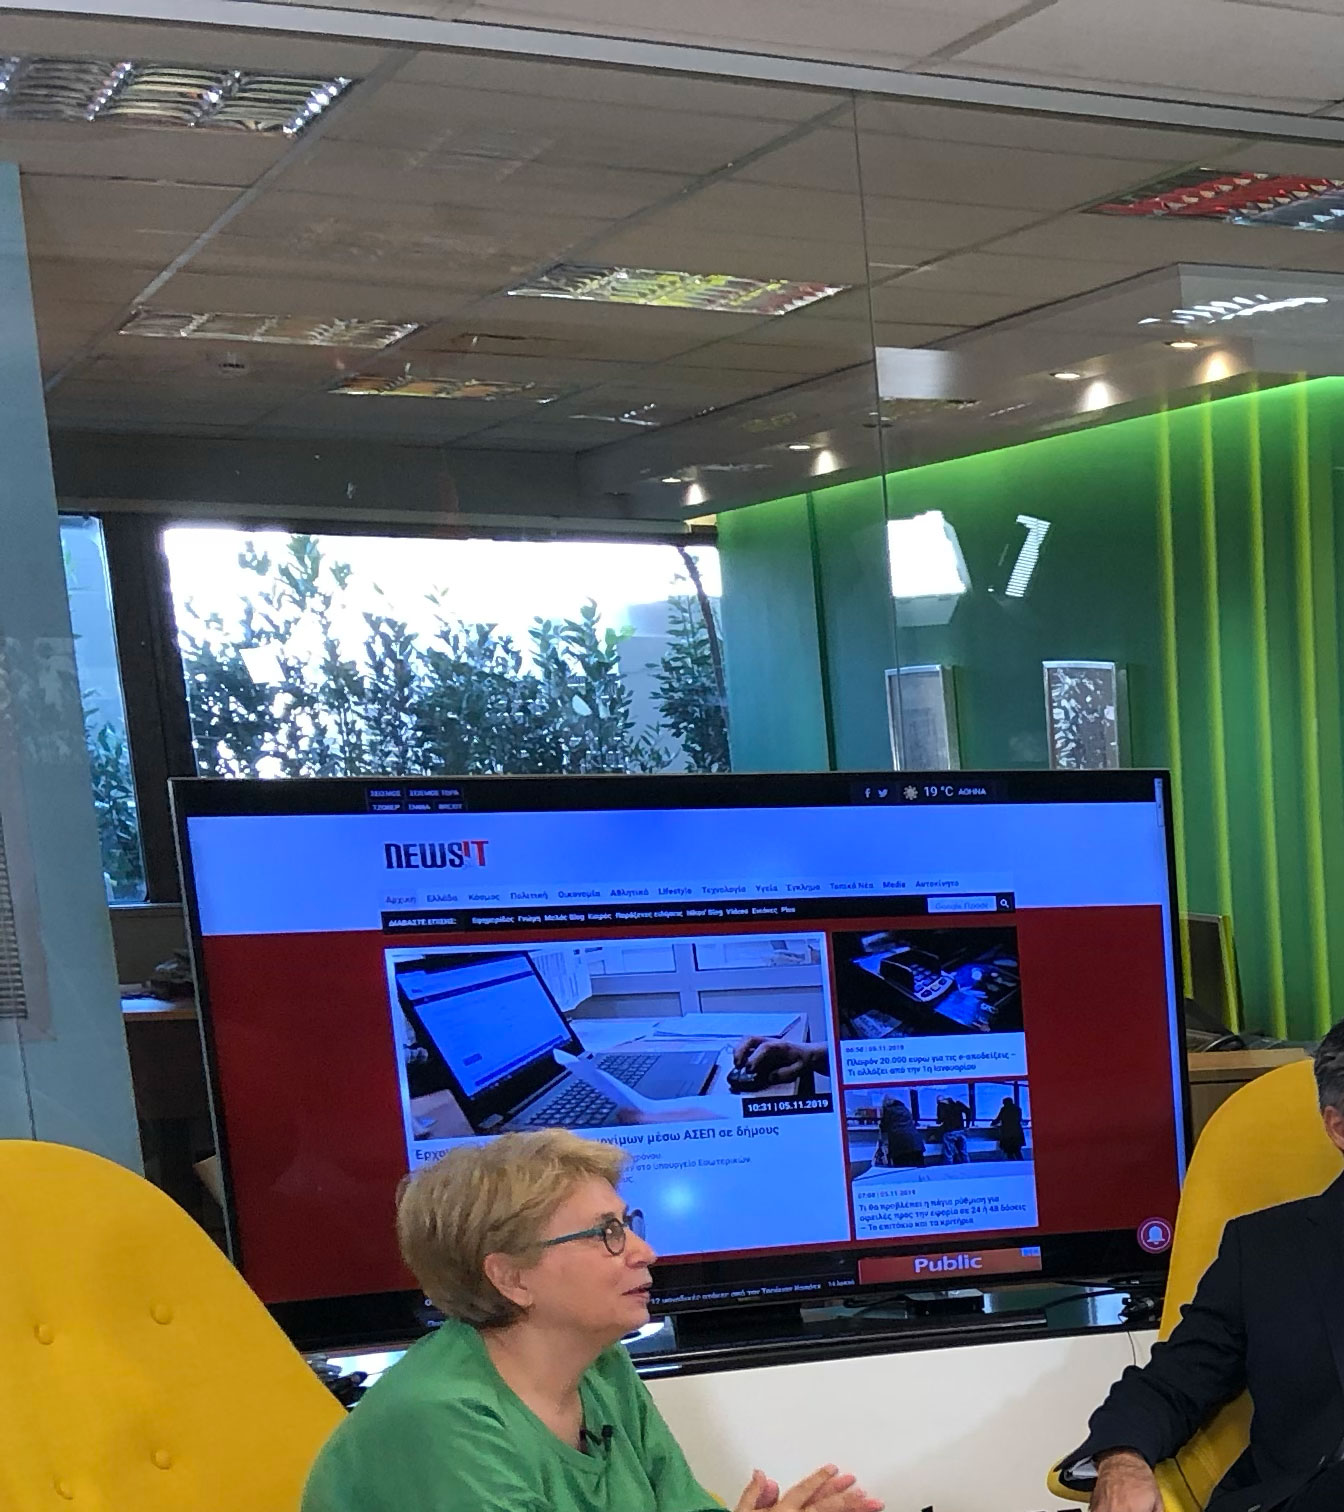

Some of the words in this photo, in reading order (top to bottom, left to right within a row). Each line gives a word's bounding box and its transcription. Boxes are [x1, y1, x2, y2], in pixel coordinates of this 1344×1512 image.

[924, 786, 938, 797] 19
[426, 894, 458, 903] Ελλάδα
[468, 892, 500, 902] Κόσμος
[558, 889, 601, 900] Οικονομία
[658, 886, 693, 897] Lifestyle
[882, 880, 906, 888] Media
[747, 1102, 773, 1113] 10:31
[778, 1100, 828, 1112] 05.11.2019
[647, 1130, 680, 1146] μέσω
[683, 1128, 716, 1140] ΑΣΕΠ
[718, 1128, 733, 1138] σε
[736, 1125, 780, 1139] δήμους
[914, 1254, 983, 1273] Public
